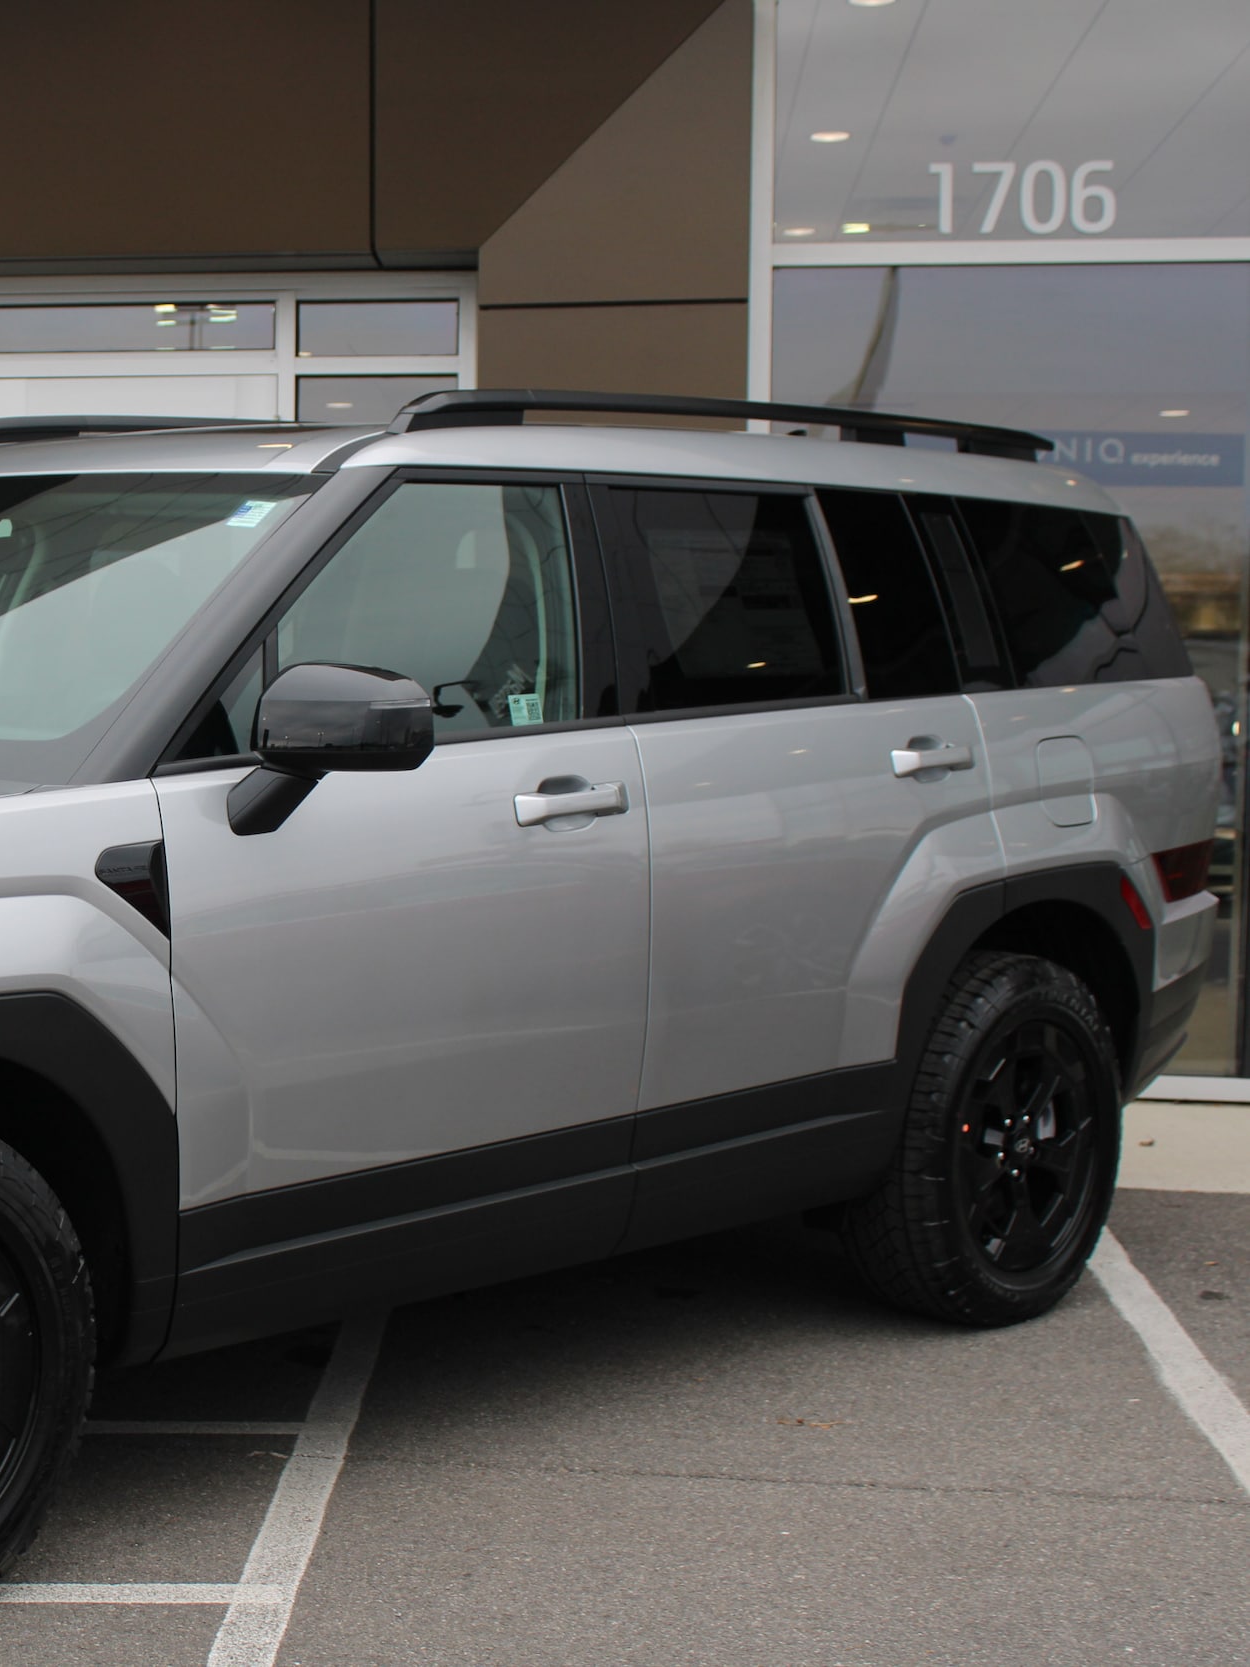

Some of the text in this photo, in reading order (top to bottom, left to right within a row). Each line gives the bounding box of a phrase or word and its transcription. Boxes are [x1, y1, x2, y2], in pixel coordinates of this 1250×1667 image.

[928, 160, 1116, 234] 1706
[1037, 438, 1221, 466] NIQ experience
